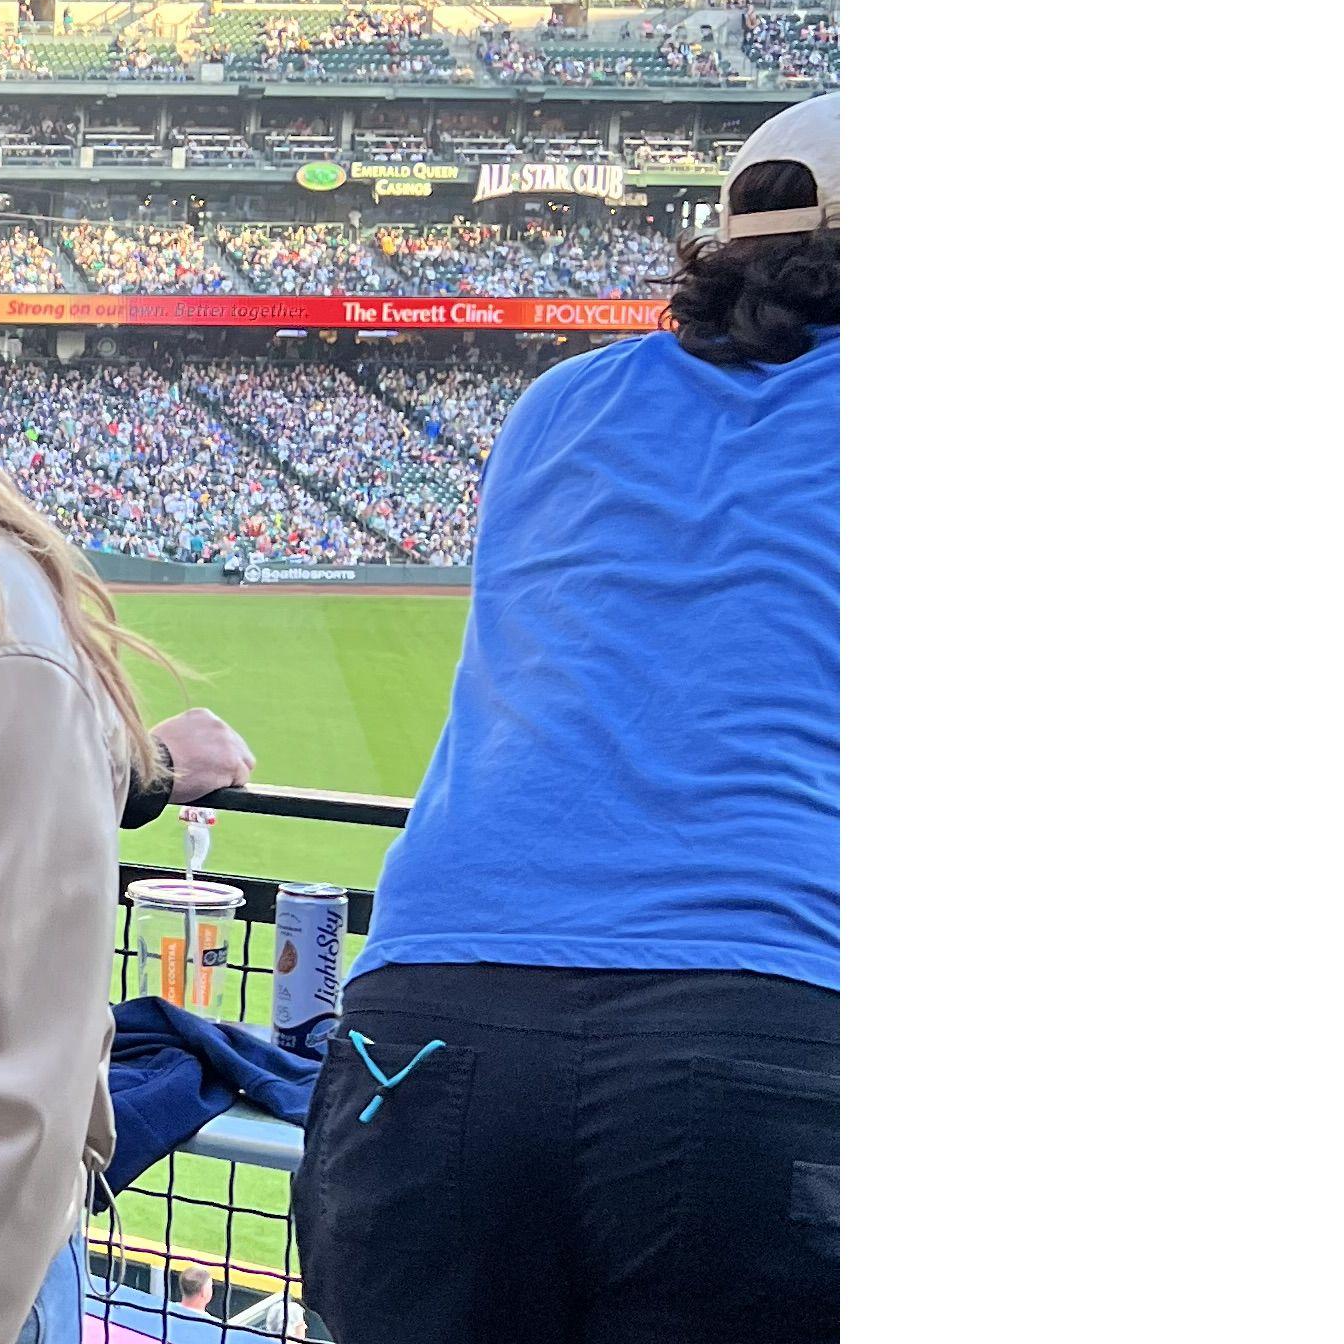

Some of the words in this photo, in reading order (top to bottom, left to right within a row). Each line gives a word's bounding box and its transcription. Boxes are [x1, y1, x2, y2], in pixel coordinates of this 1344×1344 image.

[572, 164, 624, 200] CLUB
[5, 300, 65, 319] Strong
[69, 305, 91, 316] on
[95, 306, 124, 317] our
[174, 301, 225, 318] Better
[231, 302, 309, 322] together.
[342, 301, 377, 323] The
[381, 302, 447, 323] Everett
[450, 303, 505, 324] Clinic
